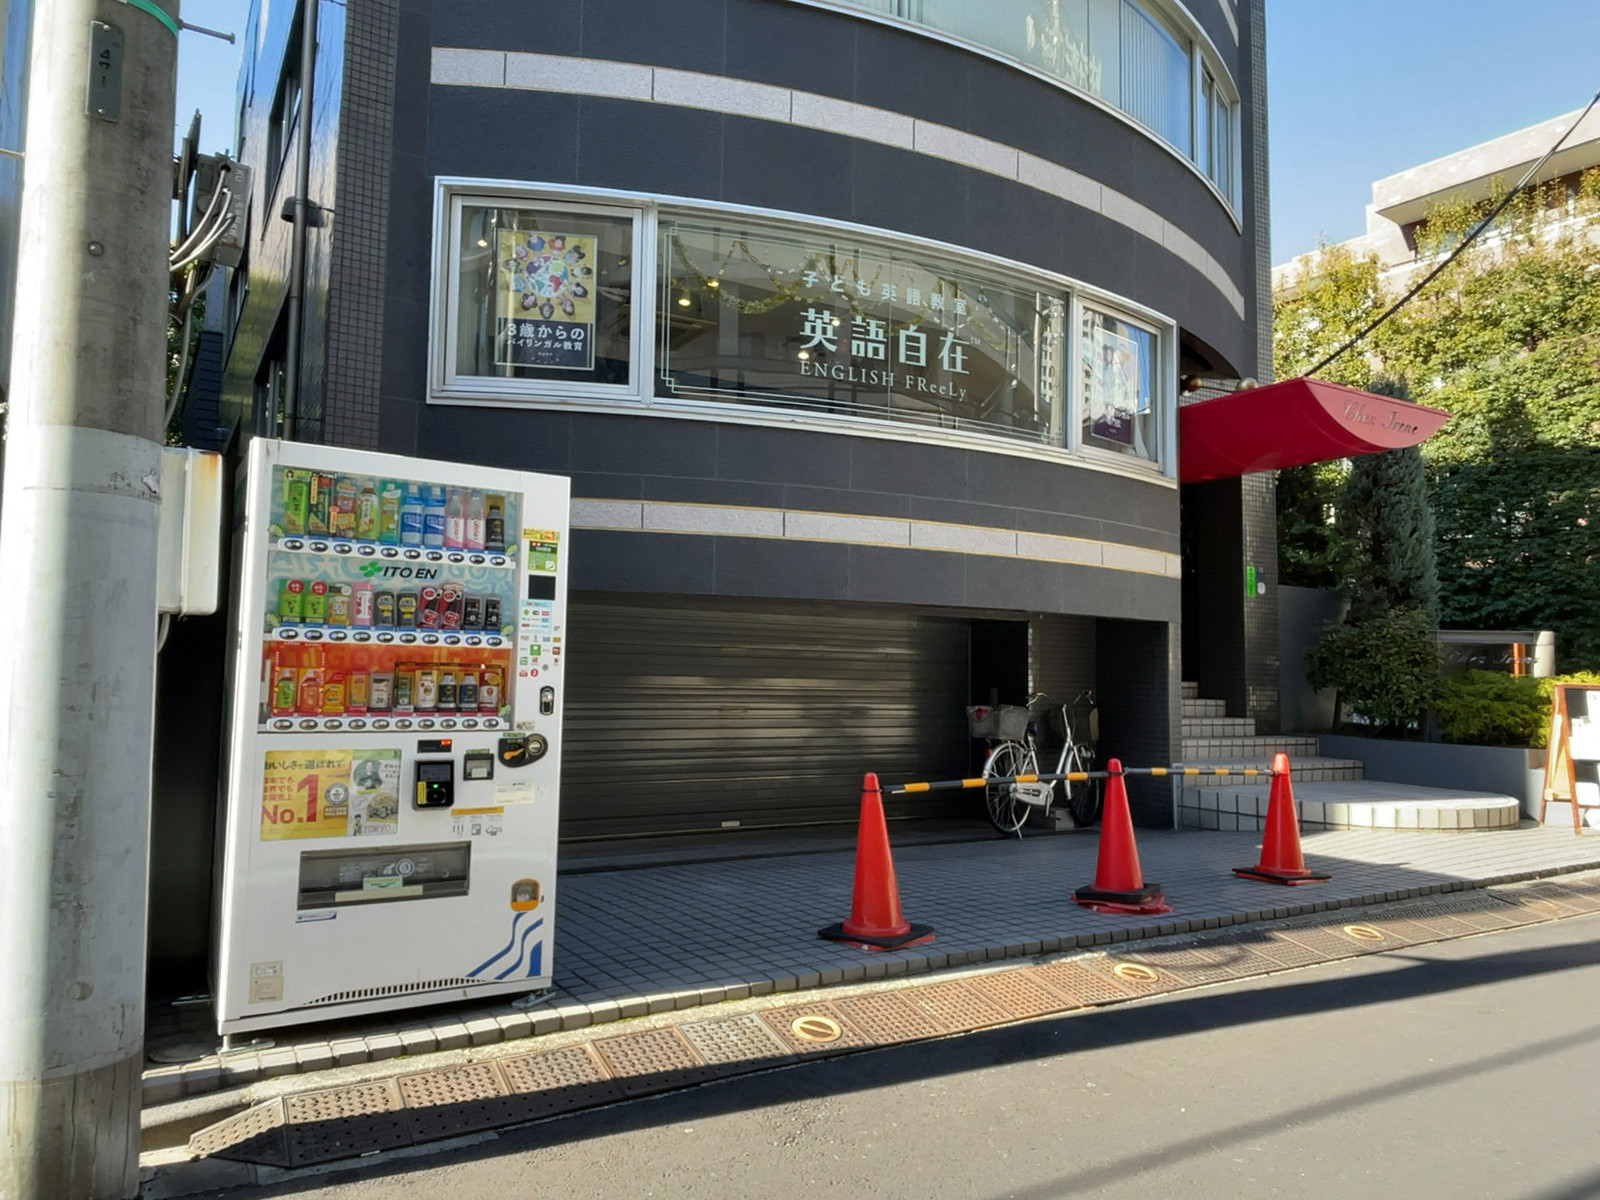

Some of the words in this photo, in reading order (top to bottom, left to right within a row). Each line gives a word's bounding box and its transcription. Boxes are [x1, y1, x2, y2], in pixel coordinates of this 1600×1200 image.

[802, 270, 967, 316] 子ども英語教室
[507, 322, 585, 341] 3歳からの
[507, 338, 583, 351] バイリンガル教育
[800, 308, 970, 375] 英語自在
[800, 360, 895, 387] ENGLISH
[905, 374, 967, 402] FReeLy
[383, 566, 413, 579] ITO
[415, 568, 437, 580] EN
